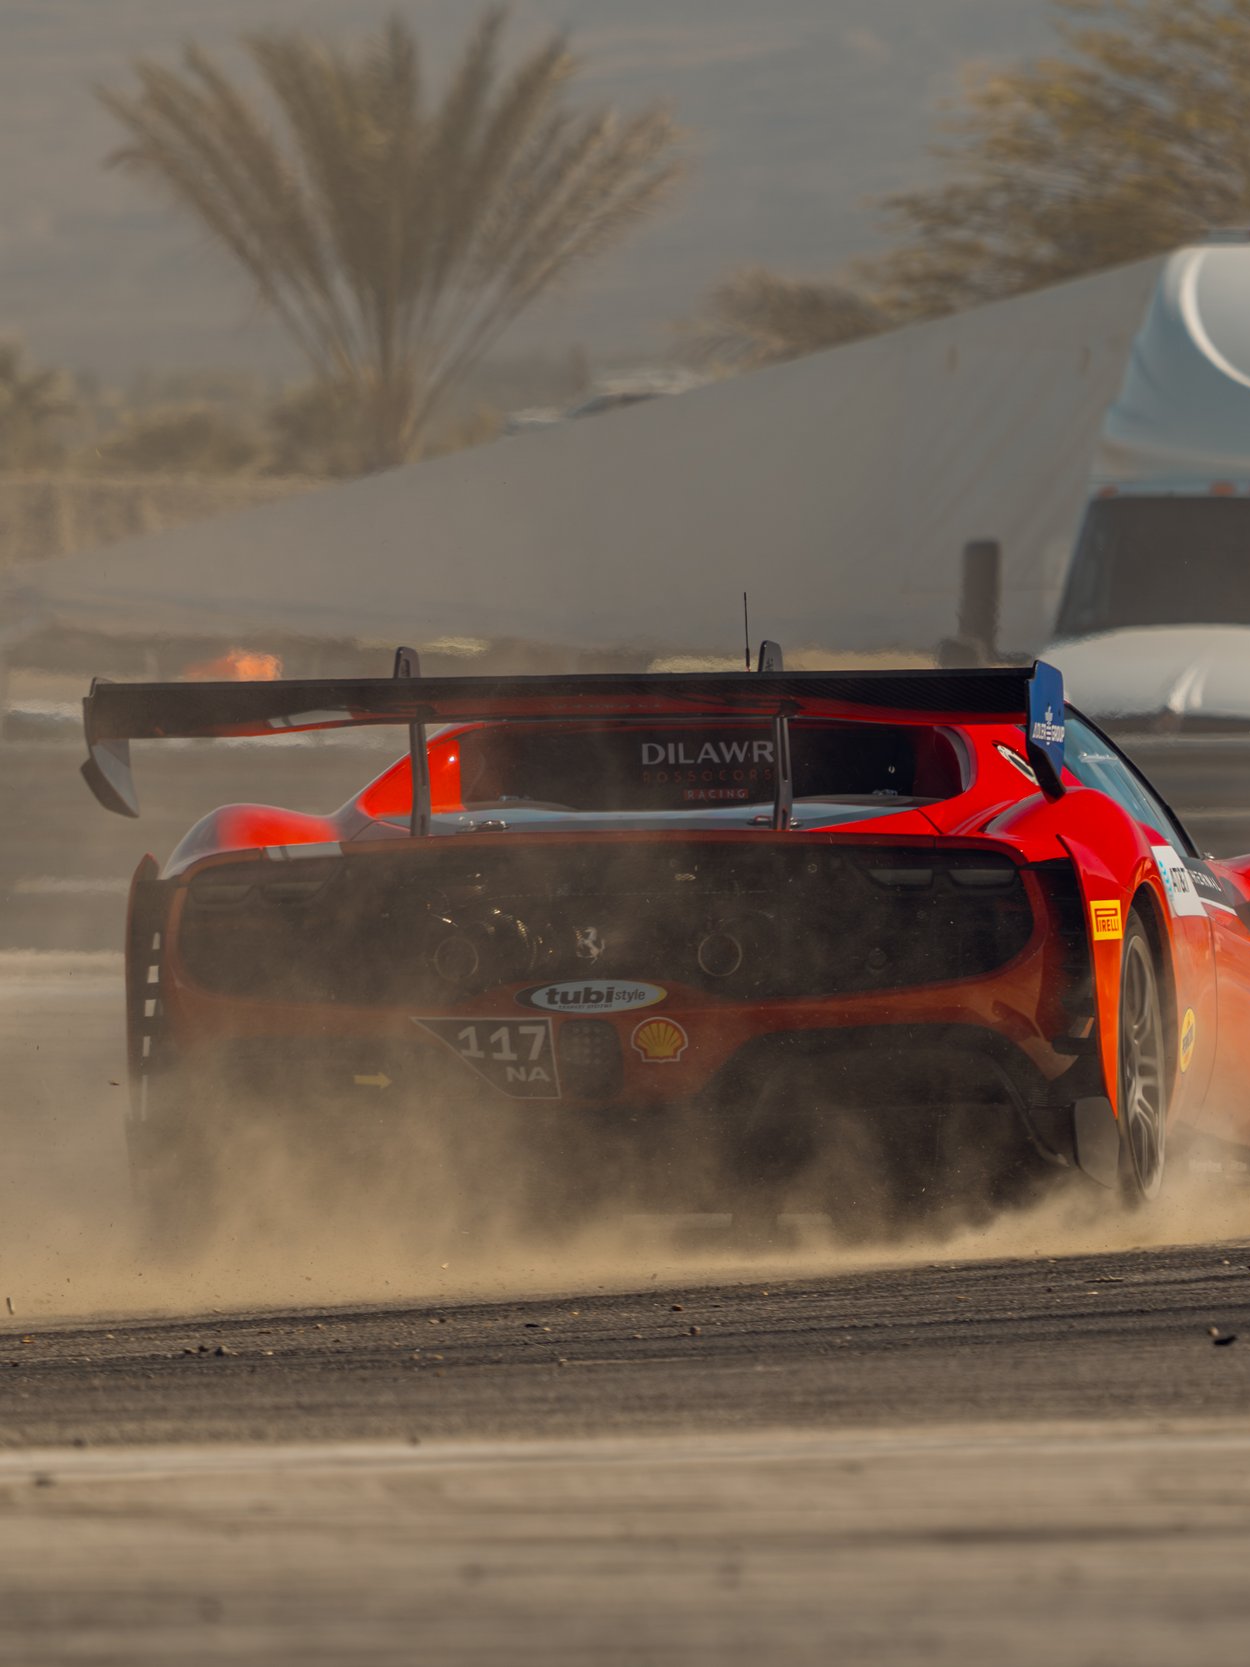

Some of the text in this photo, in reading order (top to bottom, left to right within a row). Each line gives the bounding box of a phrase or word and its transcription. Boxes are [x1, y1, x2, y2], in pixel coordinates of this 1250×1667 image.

[641, 740, 775, 765] DILAWR
[642, 767, 773, 784] ROSSOCORS
[686, 788, 746, 800] RACING
[1094, 907, 1119, 933] PIRELLI
[545, 986, 646, 1006] tubi style
[457, 1025, 546, 1061] 117
[506, 1066, 551, 1082] NA
